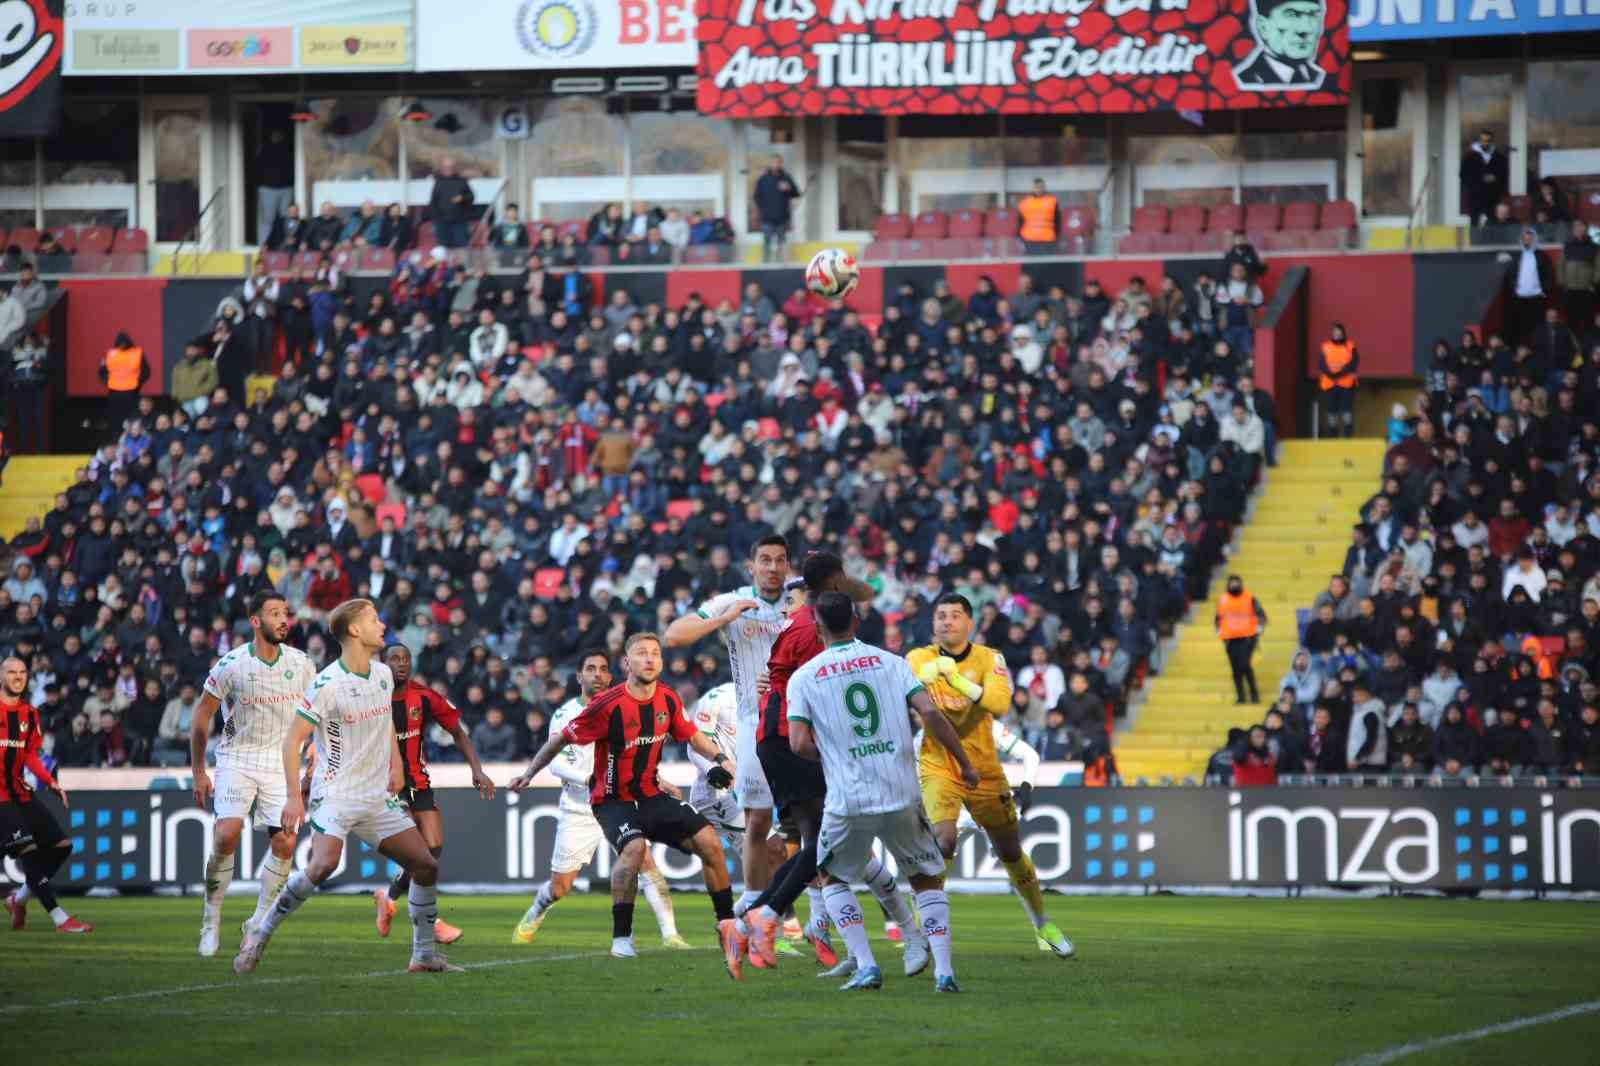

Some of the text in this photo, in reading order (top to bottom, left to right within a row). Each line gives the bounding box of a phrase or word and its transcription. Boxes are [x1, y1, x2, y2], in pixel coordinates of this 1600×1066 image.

[618, 0, 698, 44] BE
[714, 30, 1206, 88] Ama TÜRKLÜK Ebedidir
[844, 681, 881, 738] 9
[1228, 791, 1440, 884] imza
